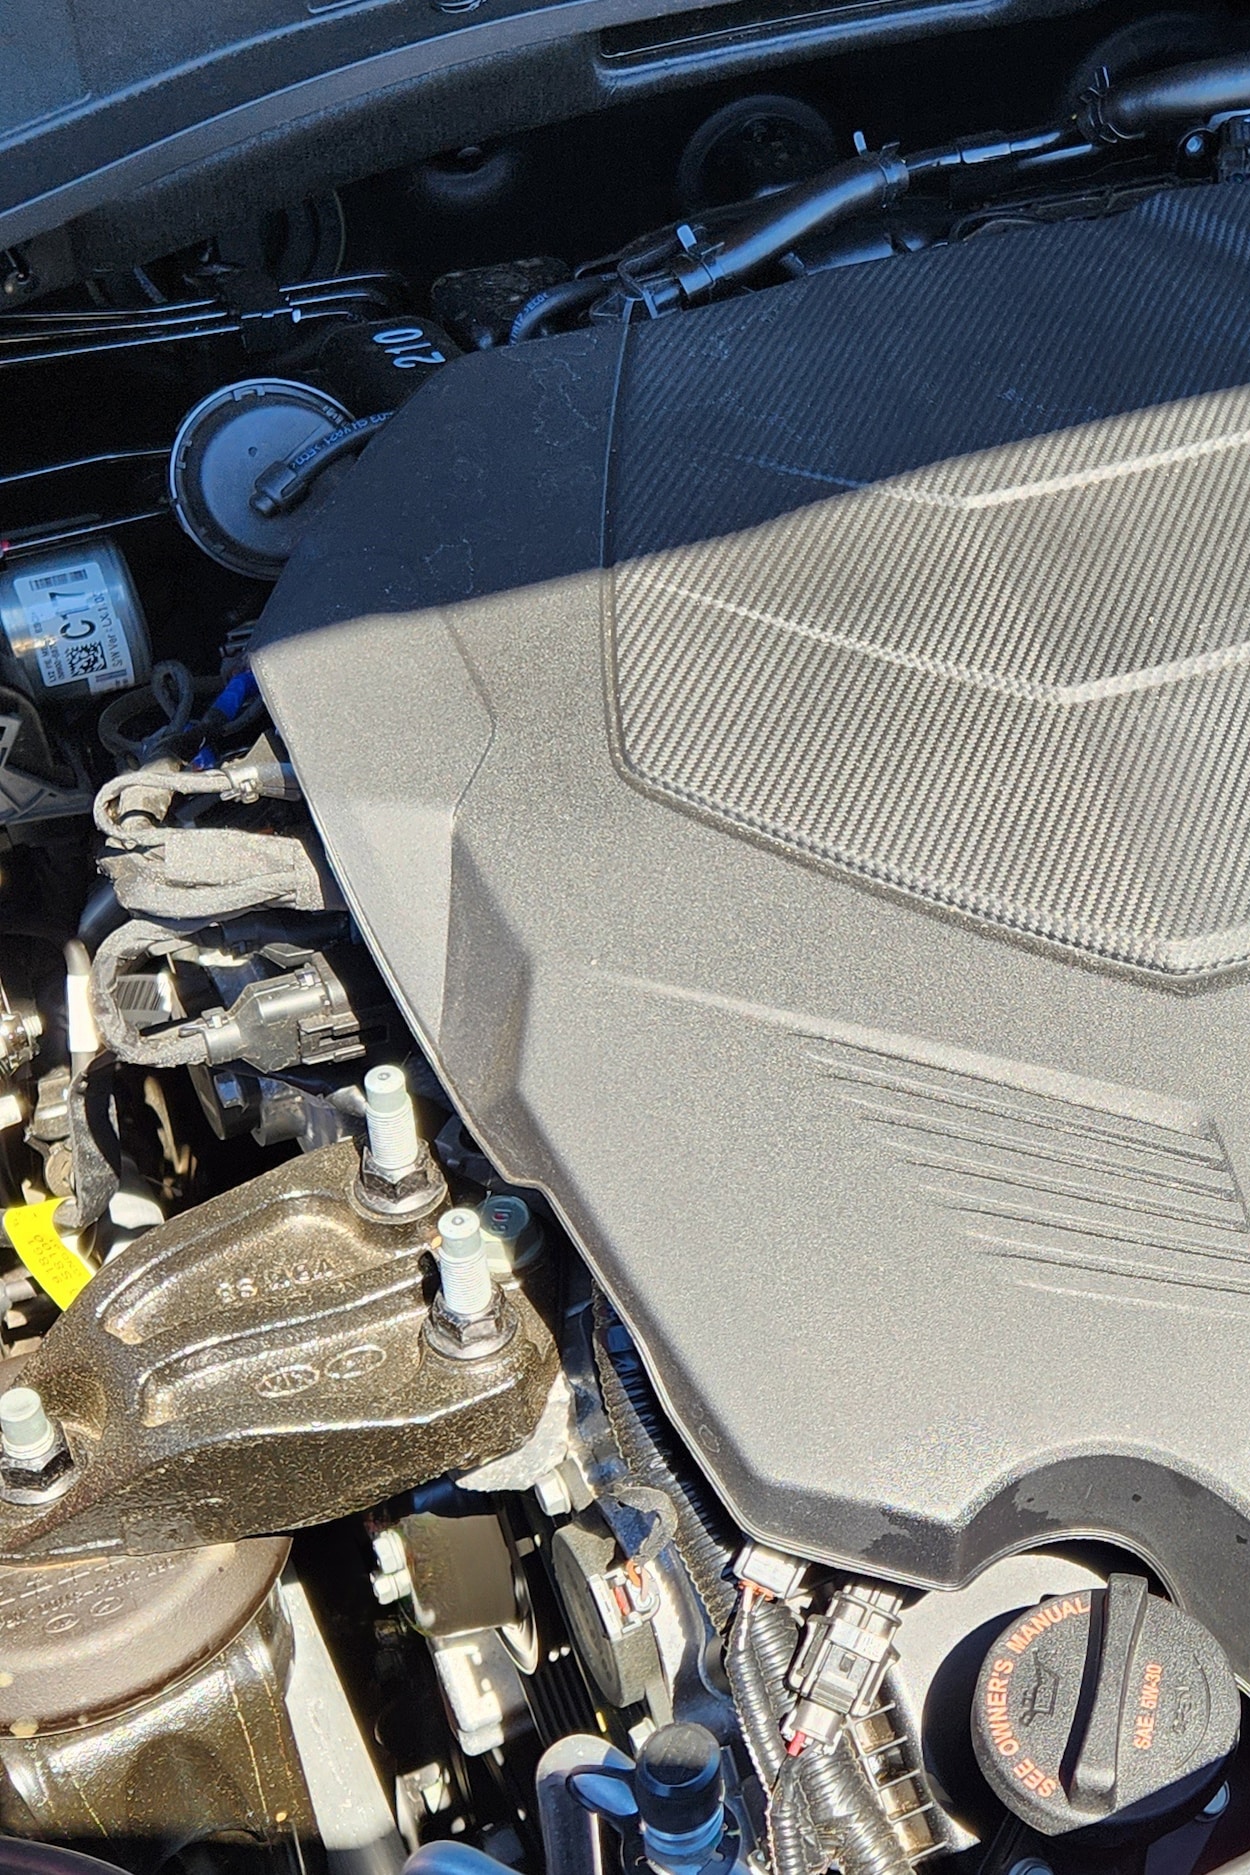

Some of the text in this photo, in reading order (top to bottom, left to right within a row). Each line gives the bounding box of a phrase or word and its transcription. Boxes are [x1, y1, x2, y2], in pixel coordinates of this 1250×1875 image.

[372, 327, 447, 370] 210
[48, 591, 97, 640] C17
[987, 1597, 1091, 1798] SEE OWNER'S MANUAL
[1132, 1662, 1163, 1750] SAE 5W-30
